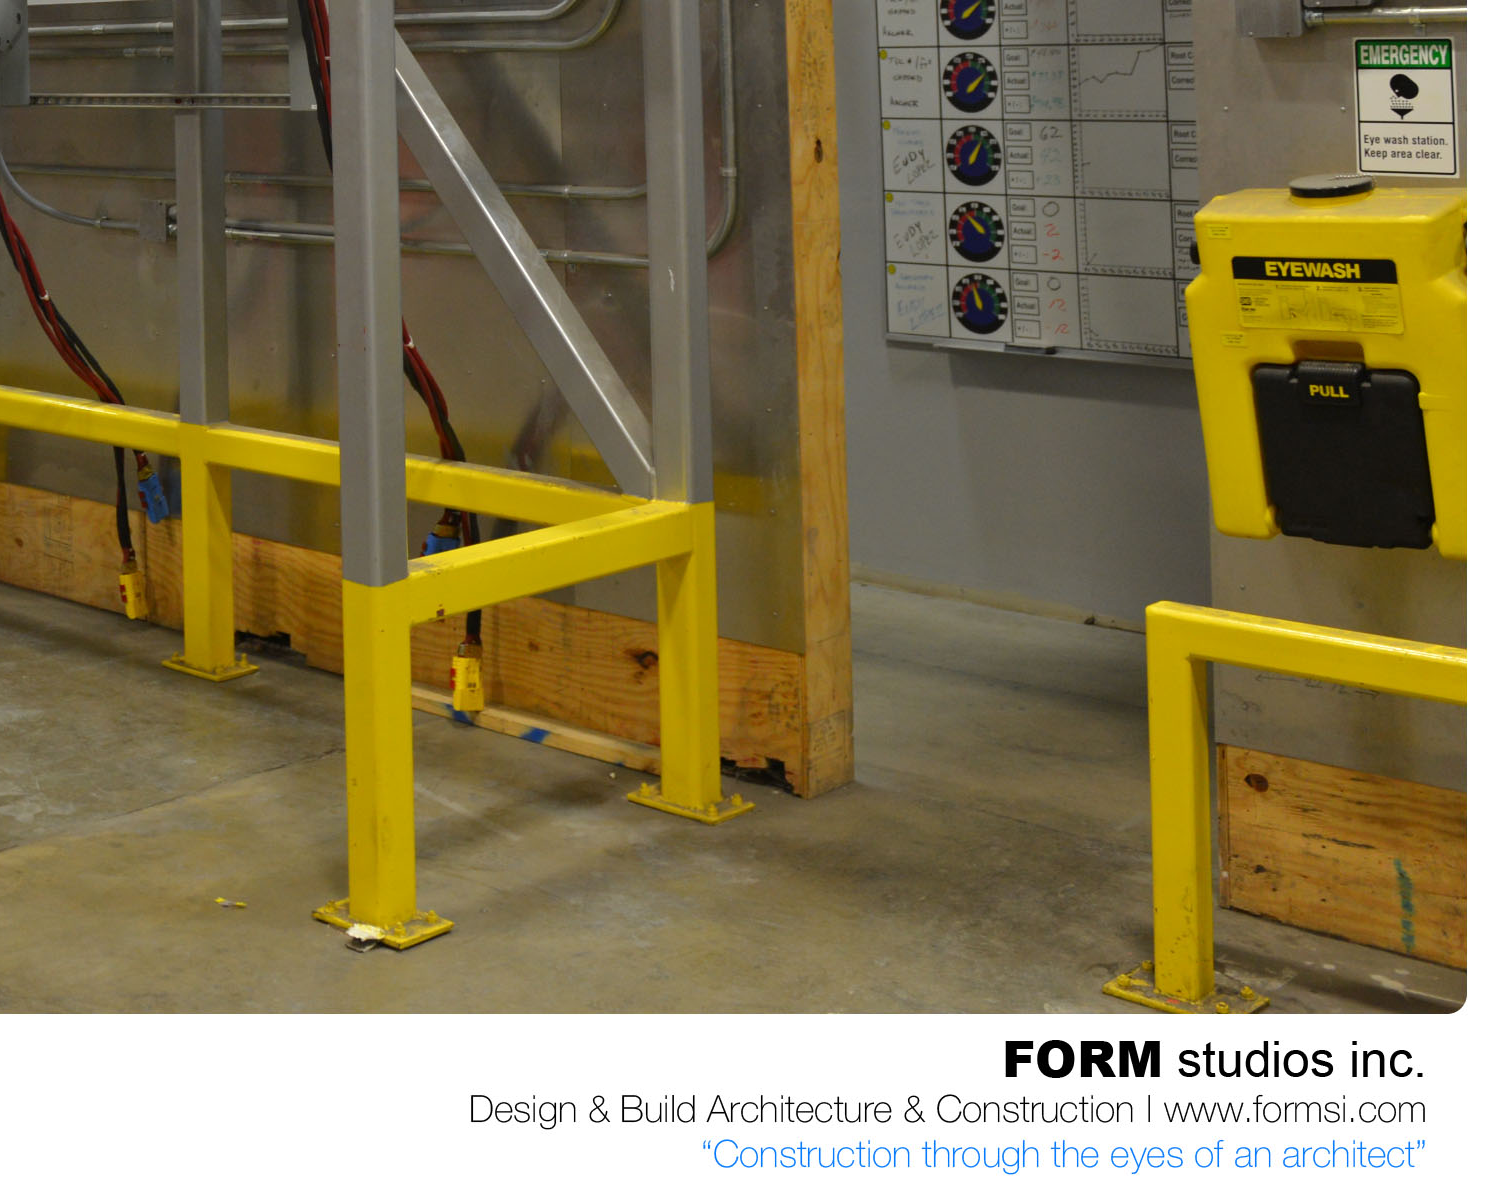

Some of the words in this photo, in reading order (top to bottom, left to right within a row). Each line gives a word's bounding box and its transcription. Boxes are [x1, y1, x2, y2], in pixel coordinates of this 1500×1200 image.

[1360, 44, 1448, 66] EMERGENCY
[1039, 125, 1063, 142] 62
[1363, 134, 1381, 146] Eye
[1383, 135, 1409, 145] wash
[1411, 136, 1448, 146] station.
[1364, 148, 1388, 160] Keep
[1391, 150, 1412, 159] area
[1415, 149, 1442, 160] clear.
[1264, 261, 1361, 279] EYEWASH
[1309, 384, 1349, 398] PULL
